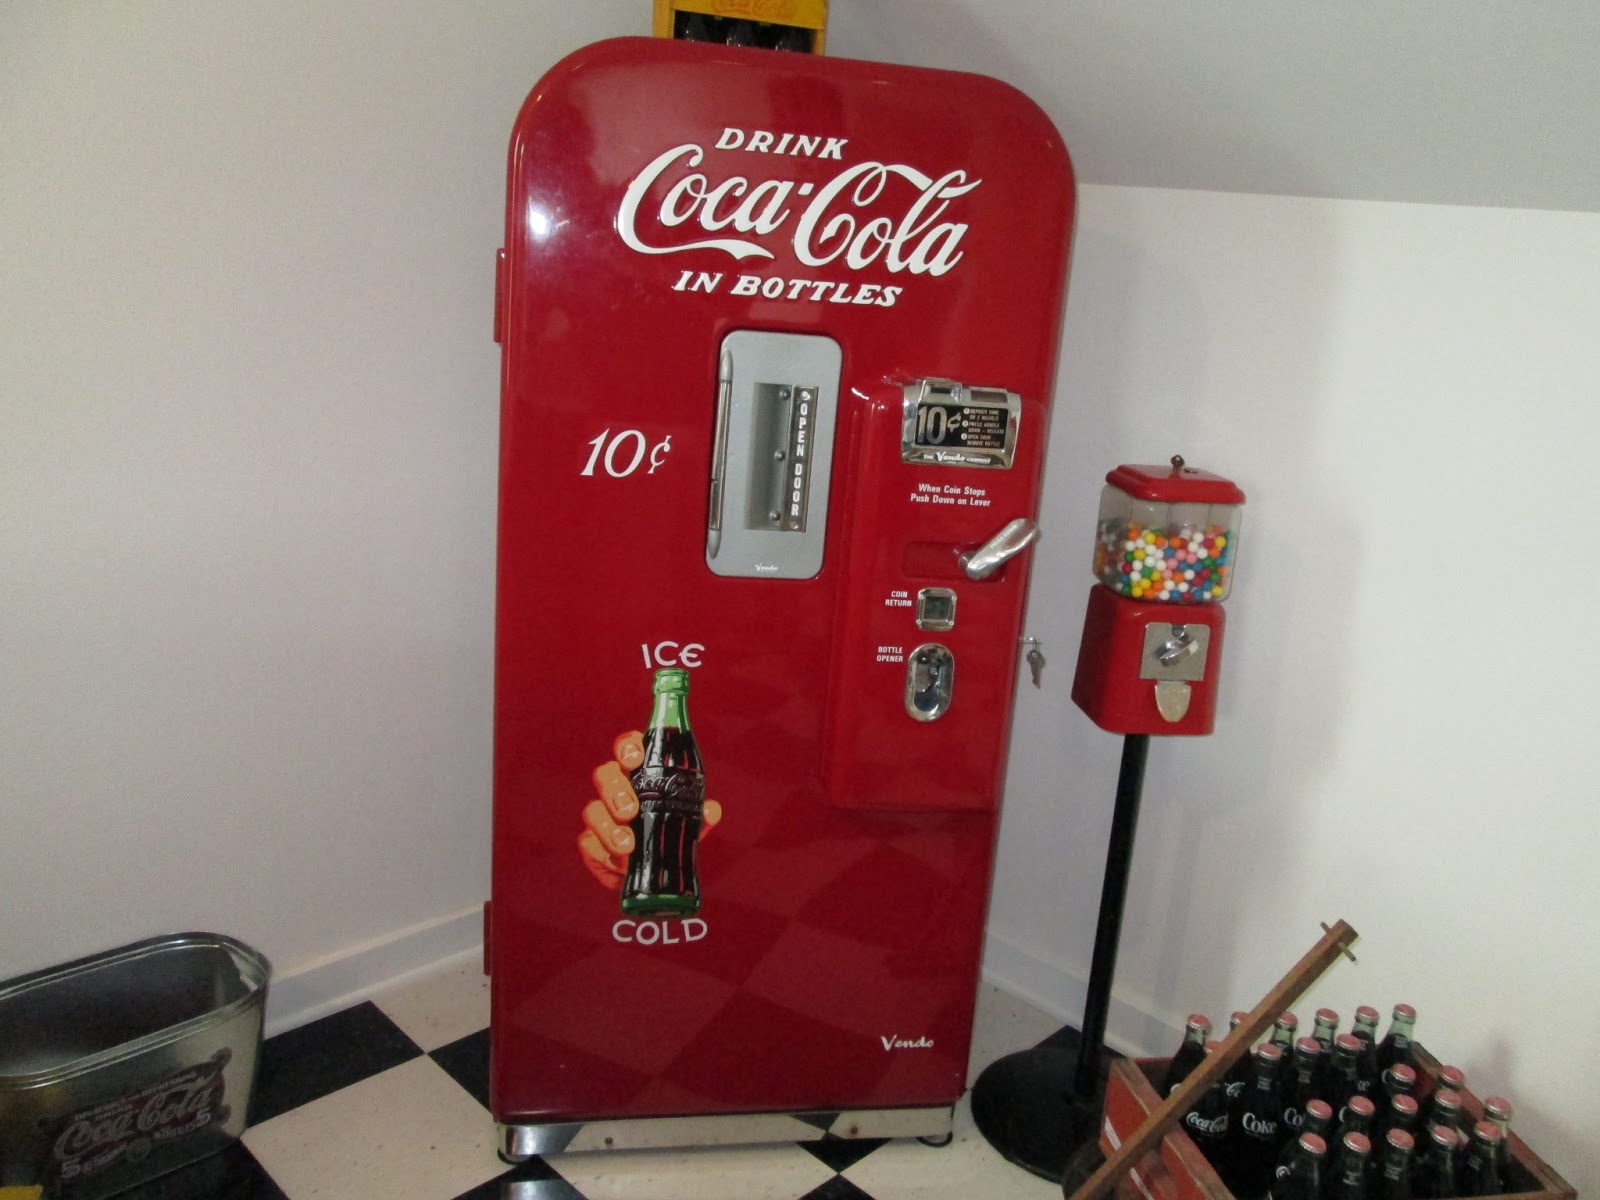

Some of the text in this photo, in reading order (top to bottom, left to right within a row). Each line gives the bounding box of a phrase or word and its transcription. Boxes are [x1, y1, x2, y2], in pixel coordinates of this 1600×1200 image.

[715, 127, 848, 160] DRINK
[613, 144, 982, 277] Coca-Cola
[671, 270, 903, 307] IN BOTTLES
[917, 406, 962, 444] 10¢
[580, 427, 672, 478] 10¢
[790, 402, 809, 517] OPEN DOOR
[936, 451, 966, 462] Vendo
[910, 493, 930, 503] Push
[932, 495, 955, 504] Down
[969, 497, 992, 507] Lever
[918, 483, 986, 497] When Coin Stops
[755, 563, 779, 573] Vendo
[885, 599, 912, 607] RETURN
[891, 590, 908, 598] COIN
[641, 641, 705, 669] ICE
[878, 646, 903, 654] BOTTLE
[612, 919, 708, 945] COLD
[880, 1033, 934, 1051] Vendo
[1241, 1112, 1277, 1134] Coke
